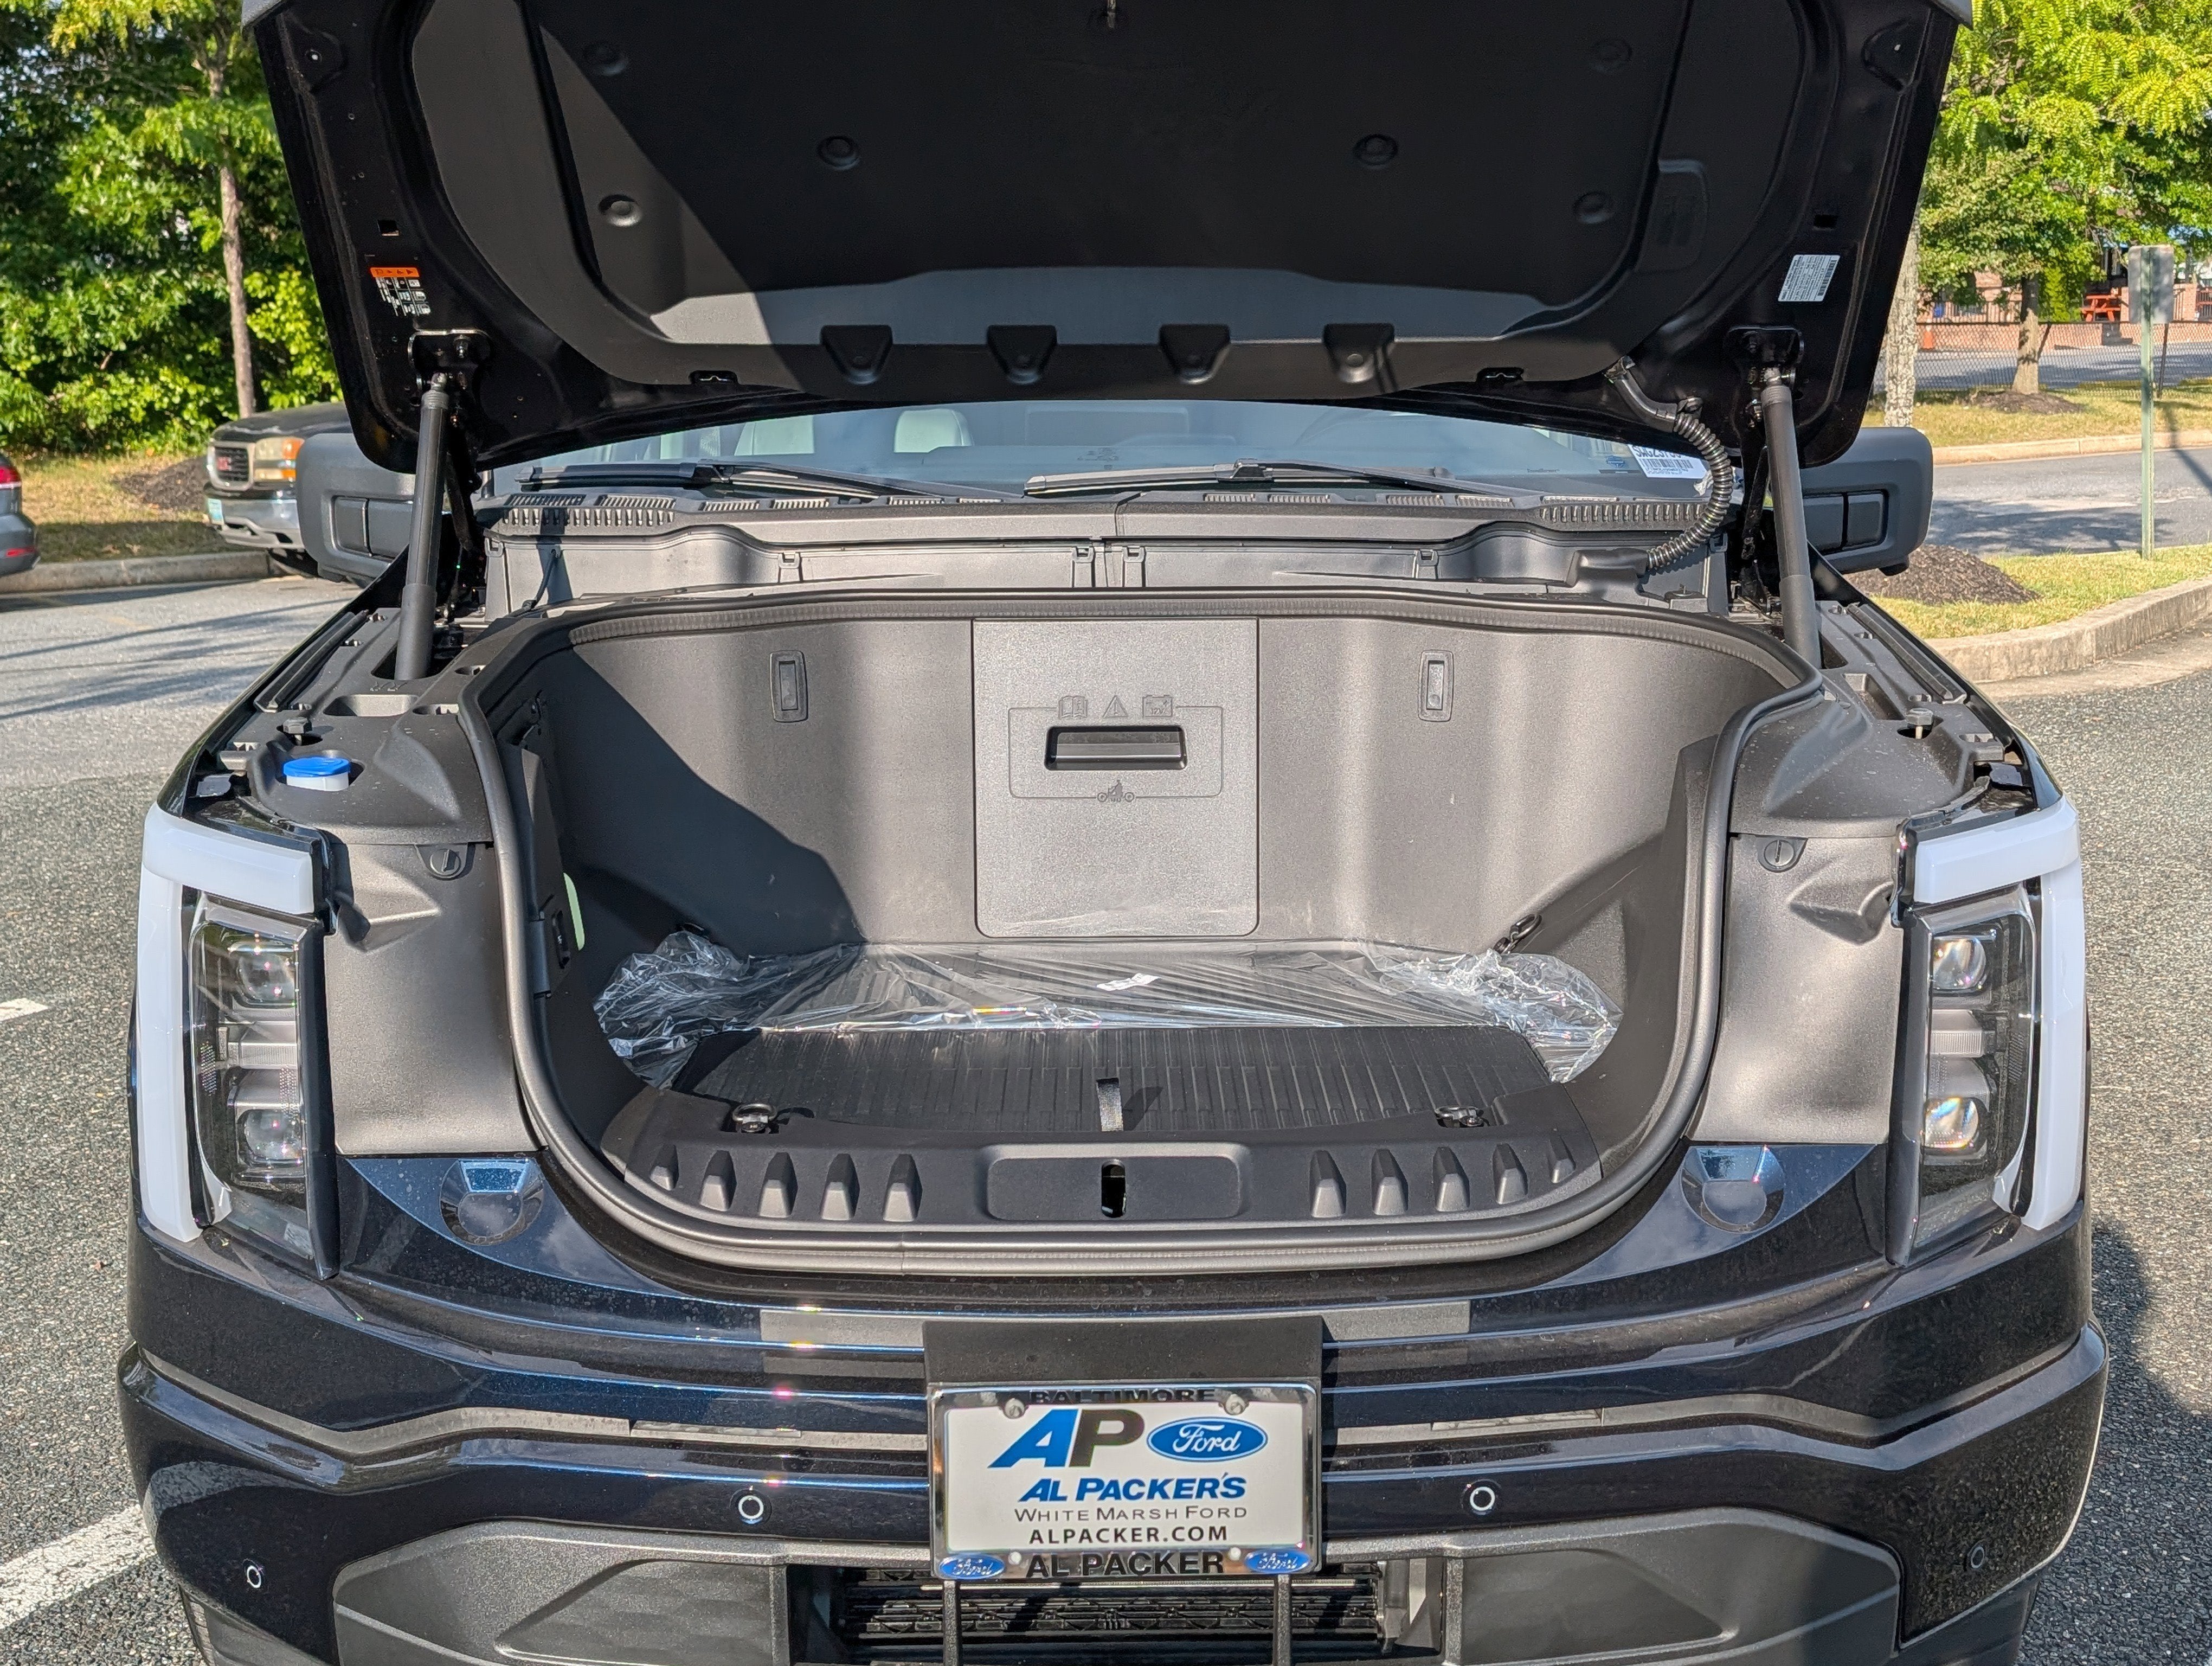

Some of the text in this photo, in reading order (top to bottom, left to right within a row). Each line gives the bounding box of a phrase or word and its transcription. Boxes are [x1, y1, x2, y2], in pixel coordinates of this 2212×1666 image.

[1030, 1388, 1215, 1403] BALTIMORE
[987, 1408, 1145, 1468] AP
[1172, 1422, 1241, 1453] Ford
[1030, 1526, 1228, 1544] ALPACKER.COM
[1026, 1550, 1224, 1578] AL PACKER
